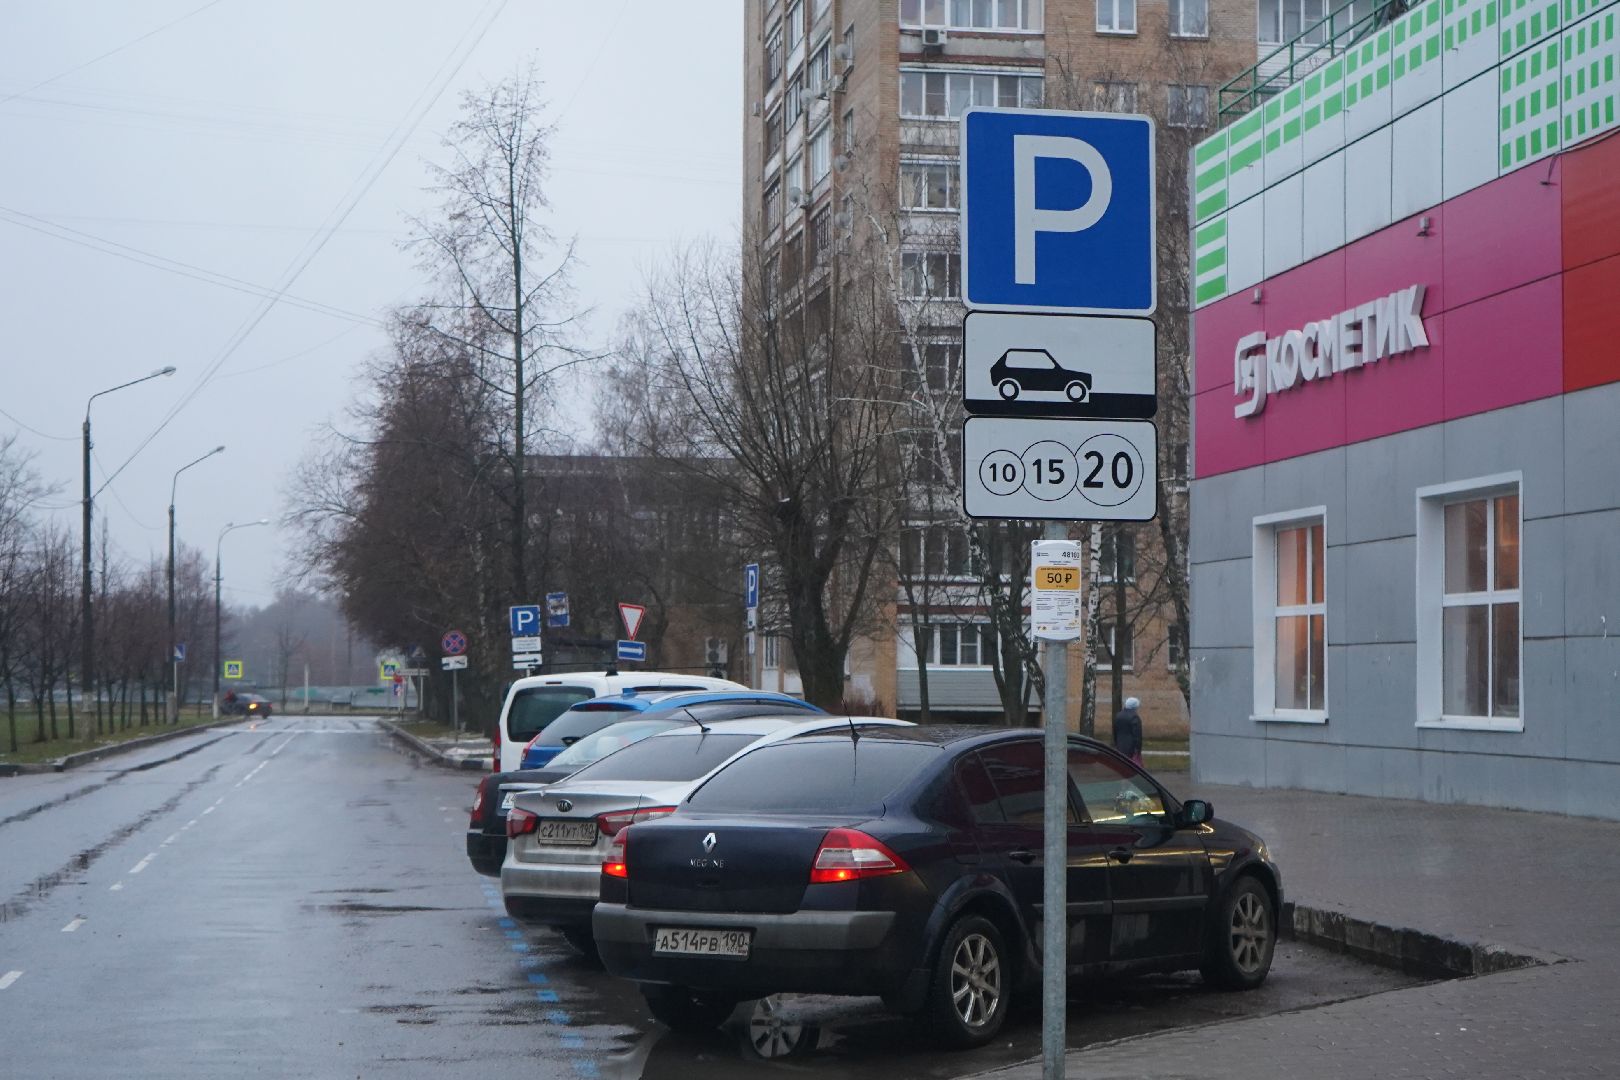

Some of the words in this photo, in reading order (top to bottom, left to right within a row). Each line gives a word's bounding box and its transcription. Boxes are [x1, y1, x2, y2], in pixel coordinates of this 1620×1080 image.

[1013, 134, 1113, 285] P
[1266, 284, 1430, 394] КОСМЕТИК
[988, 462, 1017, 483] 10
[1032, 458, 1065, 485] 15
[1083, 450, 1134, 489] 20
[748, 569, 756, 604] P
[1047, 572, 1062, 584] 50
[517, 610, 534, 631] P
[690, 858, 724, 868] MEGNE
[660, 931, 719, 952] А514РВ
[722, 932, 746, 948] 190
